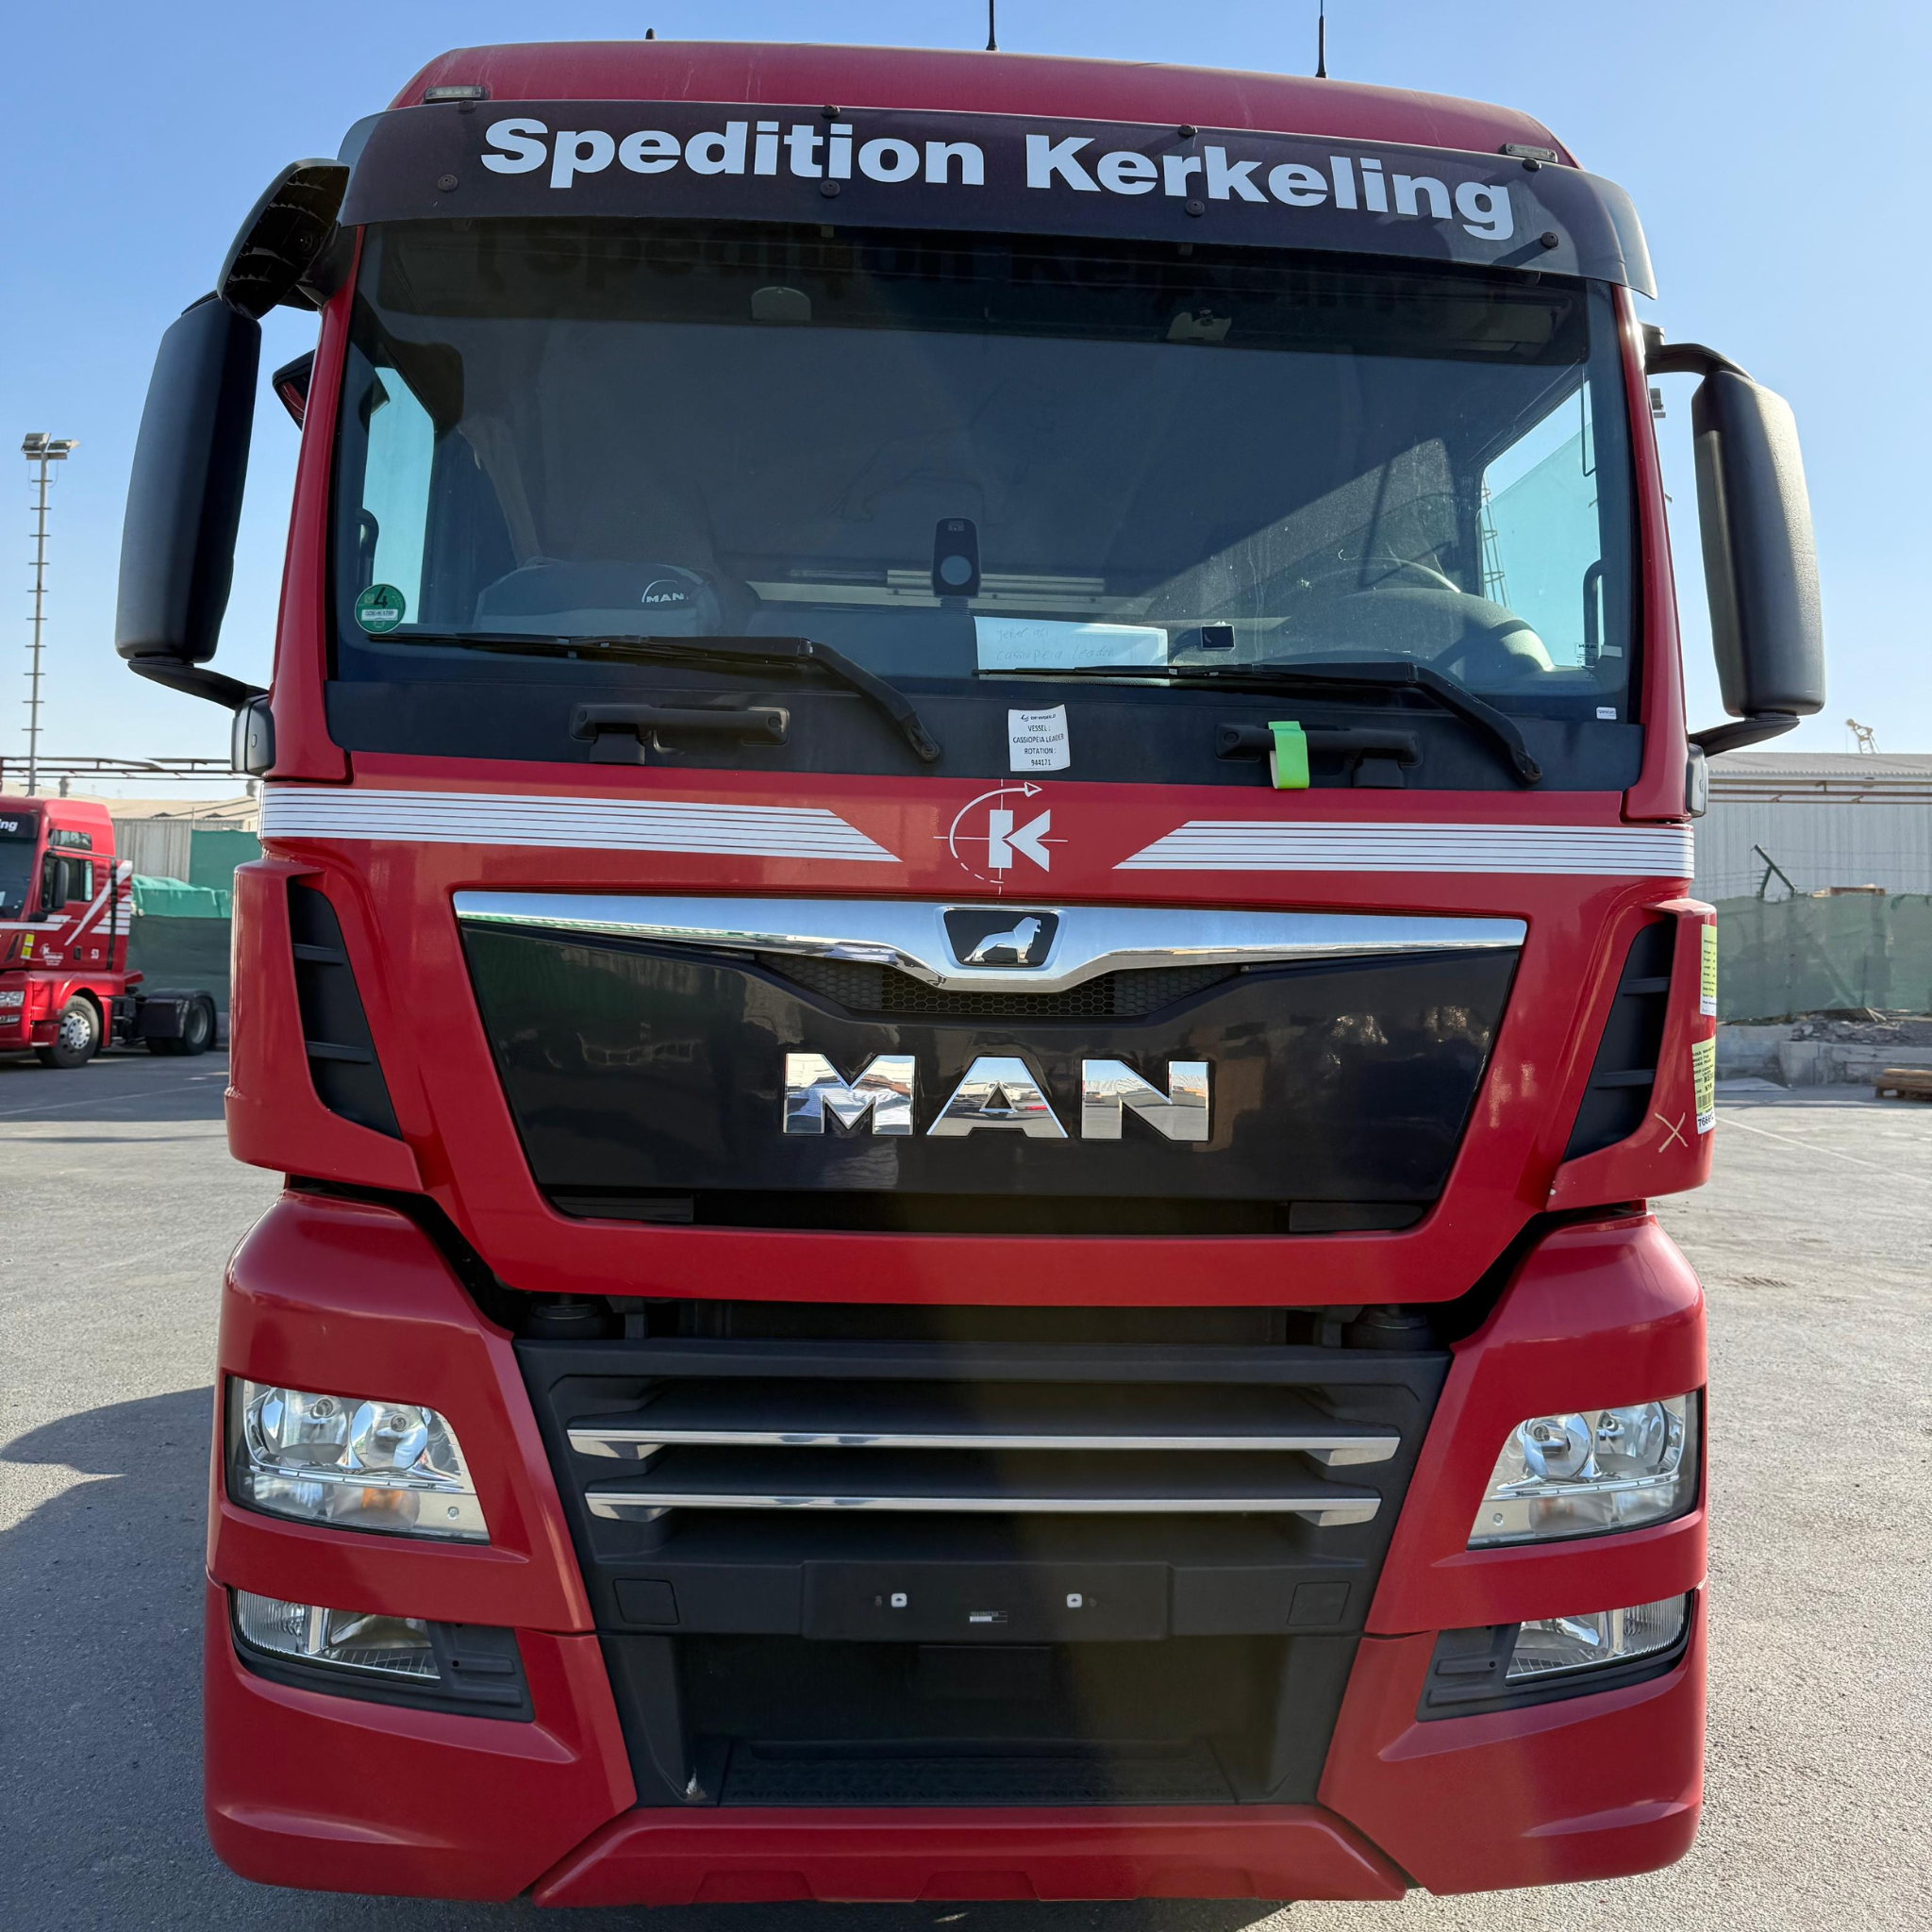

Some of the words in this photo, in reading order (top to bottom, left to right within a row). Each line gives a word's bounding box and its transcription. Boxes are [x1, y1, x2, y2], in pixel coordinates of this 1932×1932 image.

[481, 119, 984, 188] Spedition
[1026, 135, 1513, 240] Kerkeling
[374, 587, 389, 608] 4
[646, 592, 685, 603] MAN
[1045, 733, 1064, 743] LEADER
[989, 808, 1051, 873] K
[783, 1053, 1210, 1141] MAN
